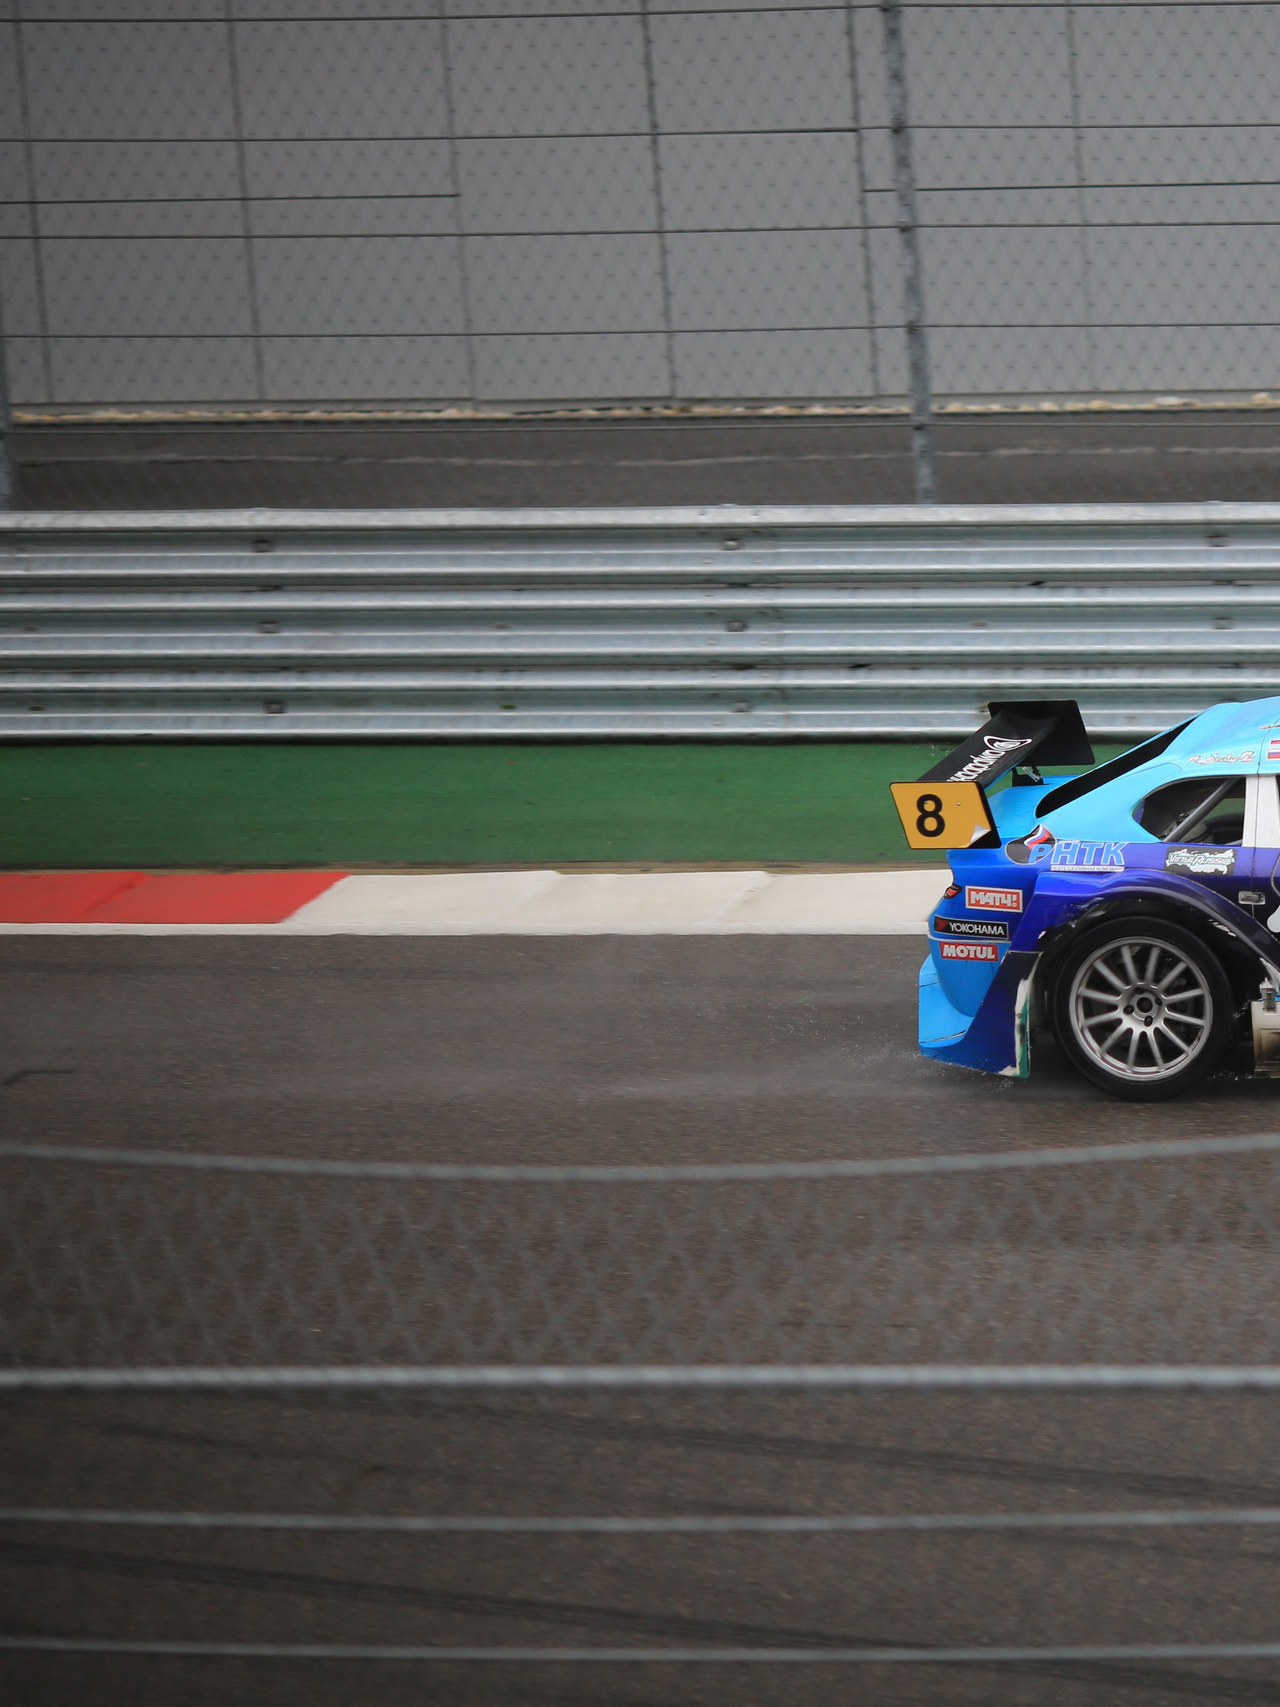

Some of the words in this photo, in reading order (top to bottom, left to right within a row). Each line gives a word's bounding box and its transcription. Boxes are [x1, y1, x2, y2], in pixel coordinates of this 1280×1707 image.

[916, 794, 945, 837] 8
[949, 923, 1005, 936] YOKOHAMA
[942, 944, 996, 960] MOTUL
